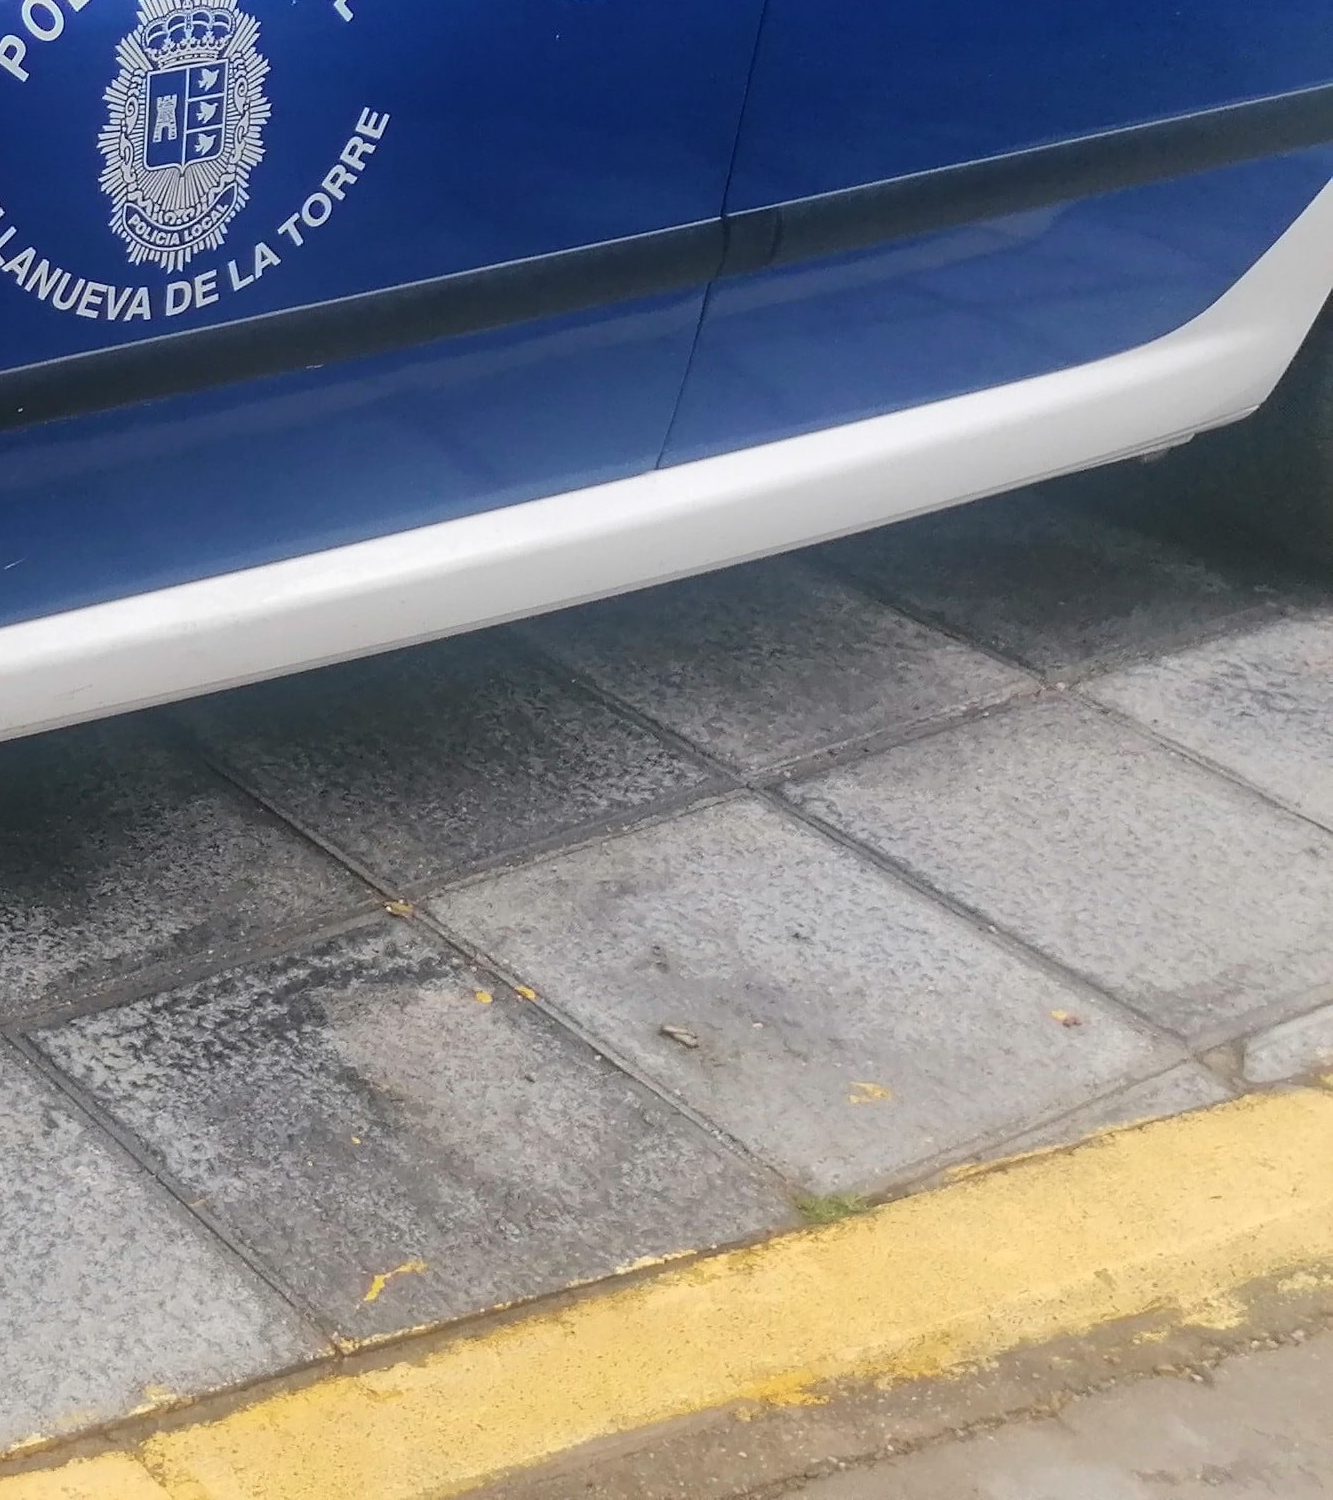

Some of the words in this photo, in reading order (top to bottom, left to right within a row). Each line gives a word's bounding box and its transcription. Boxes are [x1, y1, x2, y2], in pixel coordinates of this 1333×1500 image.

[128, 214, 180, 246] POLICIA
[183, 204, 229, 242] LOCAL
[165, 269, 220, 316] DE
[228, 242, 281, 291] LA
[277, 106, 391, 247] TORRE
